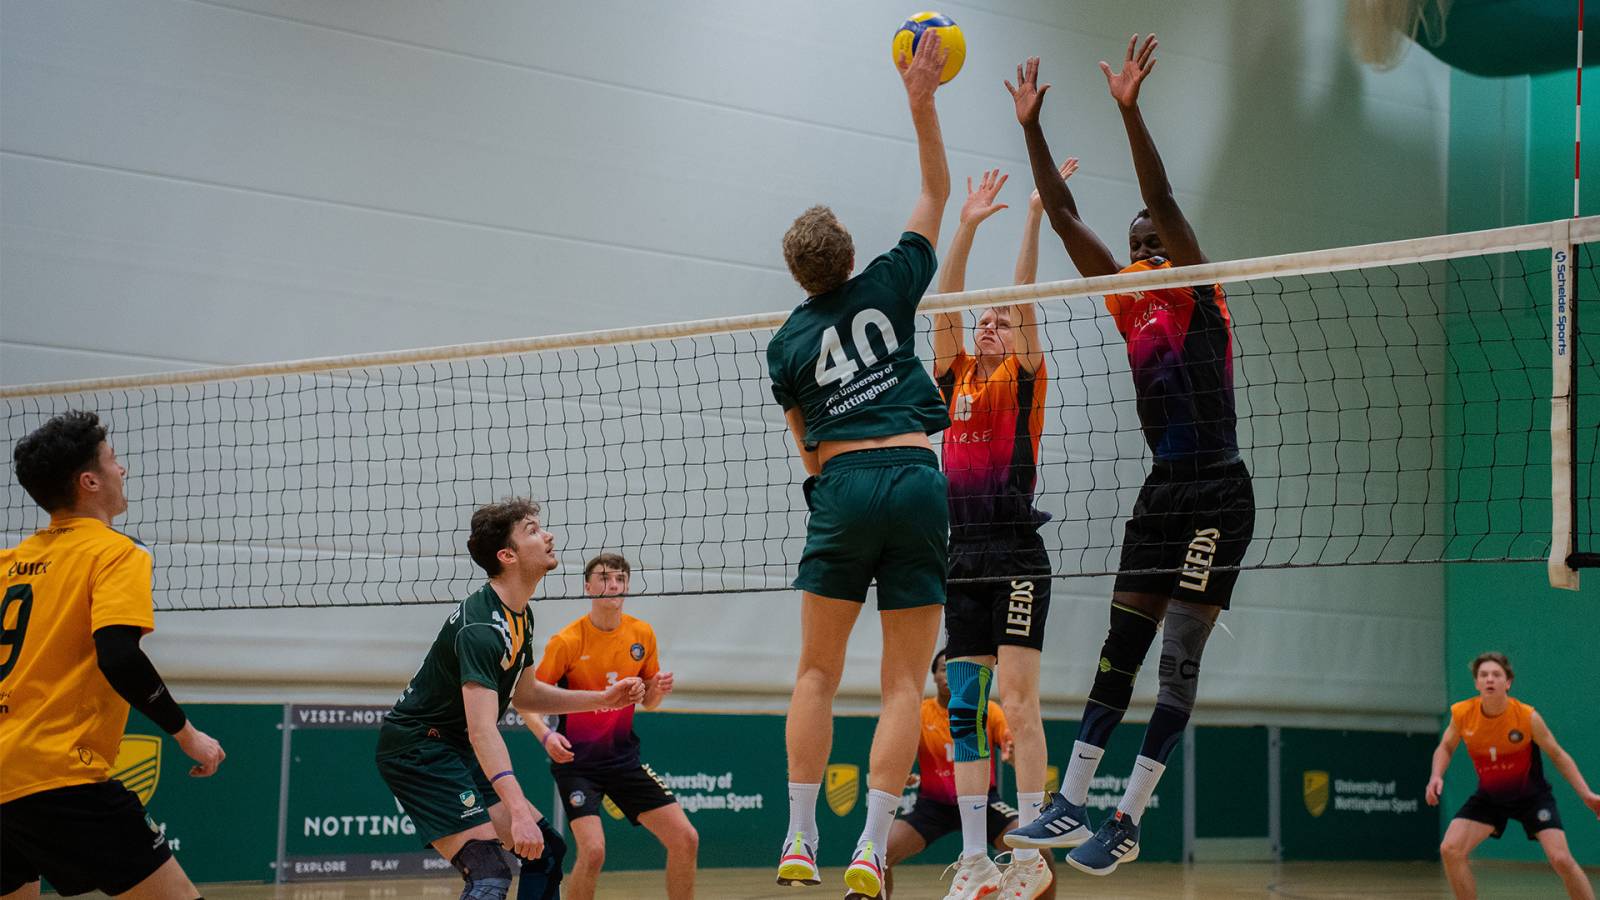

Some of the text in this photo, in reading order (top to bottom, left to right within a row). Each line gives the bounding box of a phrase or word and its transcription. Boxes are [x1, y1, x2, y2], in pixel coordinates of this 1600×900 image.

[1556, 264, 1567, 356] Schelde Sports
[814, 308, 899, 388] 40
[829, 376, 899, 416] Nottingham
[840, 370, 884, 396] University
[884, 364, 894, 374] of
[1180, 527, 1221, 592] LEEDS
[1005, 580, 1035, 637] LEEDS
[657, 772, 717, 793] iversity
[717, 772, 733, 789] of
[1334, 779, 1384, 797] University
[726, 792, 763, 812] Sport
[1334, 796, 1391, 814] Nottingham
[295, 860, 347, 874] EXPLORE
[370, 859, 400, 871] PLAY
